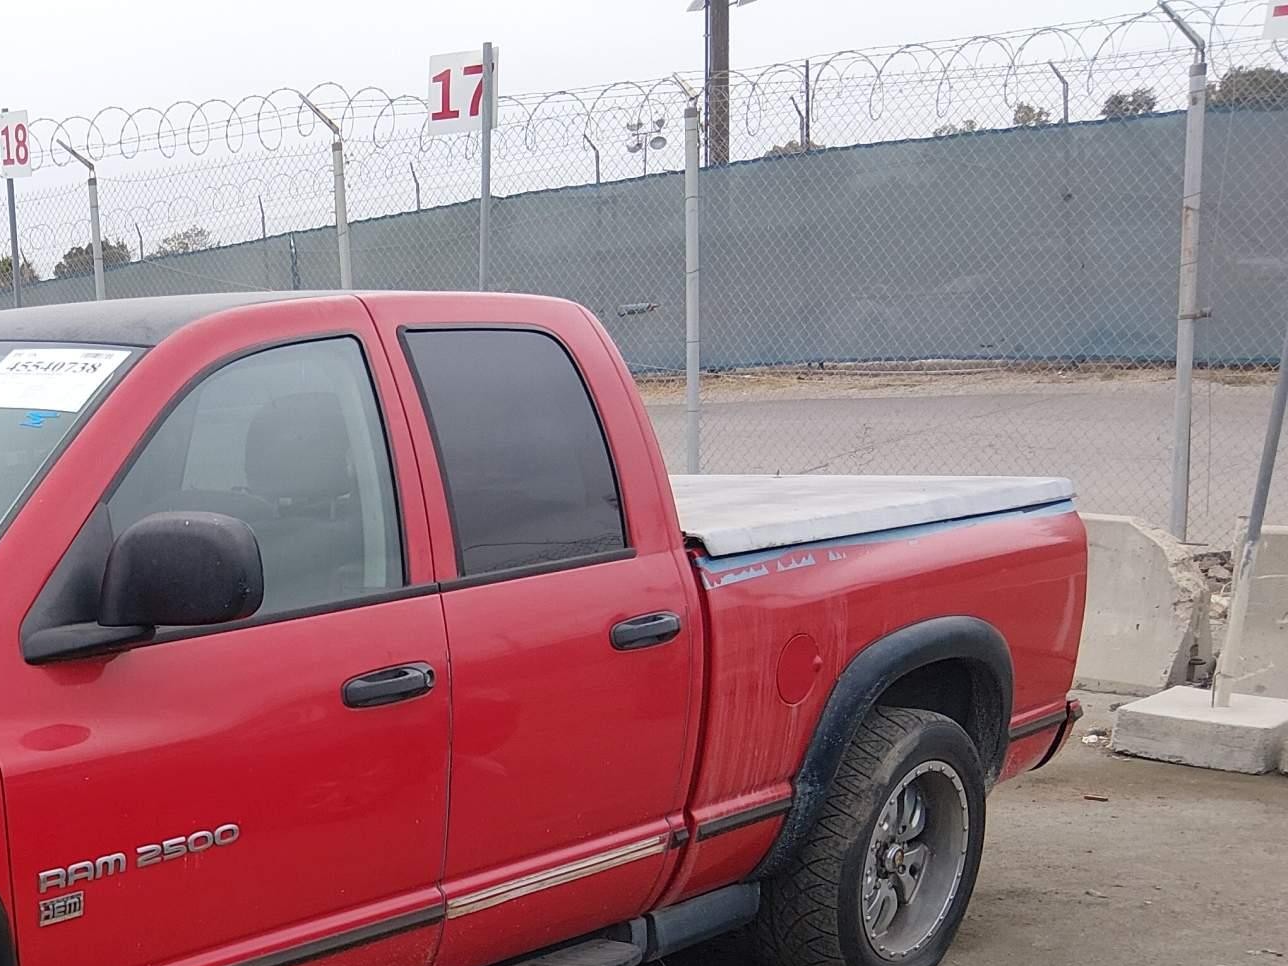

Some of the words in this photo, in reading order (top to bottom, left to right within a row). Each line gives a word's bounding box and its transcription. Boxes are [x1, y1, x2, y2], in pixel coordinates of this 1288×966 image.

[431, 64, 495, 121] 17
[0, 123, 29, 166] 18
[6, 360, 103, 374] 45540738
[38, 852, 127, 894] RAM
[136, 823, 240, 869] 2500
